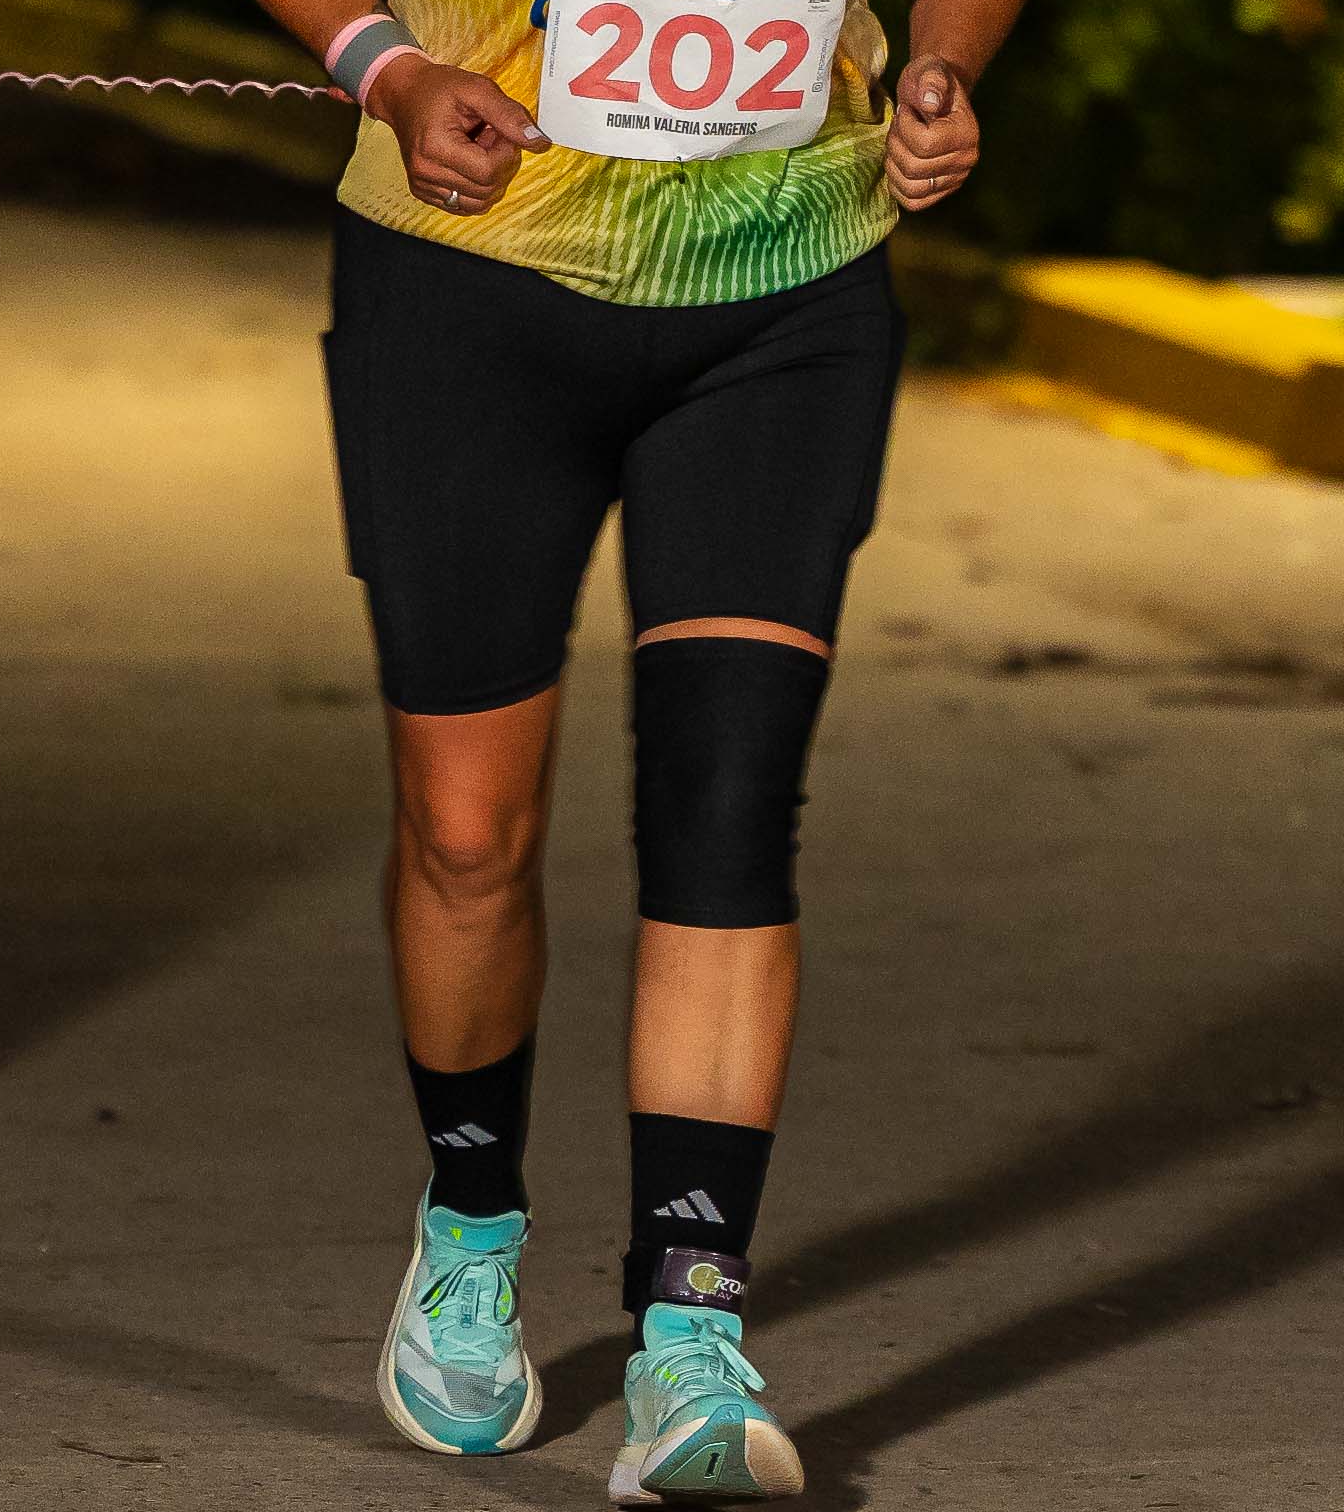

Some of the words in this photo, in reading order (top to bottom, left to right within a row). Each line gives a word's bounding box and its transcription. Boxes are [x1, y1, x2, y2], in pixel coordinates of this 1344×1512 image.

[567, 2, 811, 112] 202
[606, 112, 650, 130] ROMINA
[654, 116, 701, 136] VALERIA
[703, 121, 758, 137] SANGENIS
